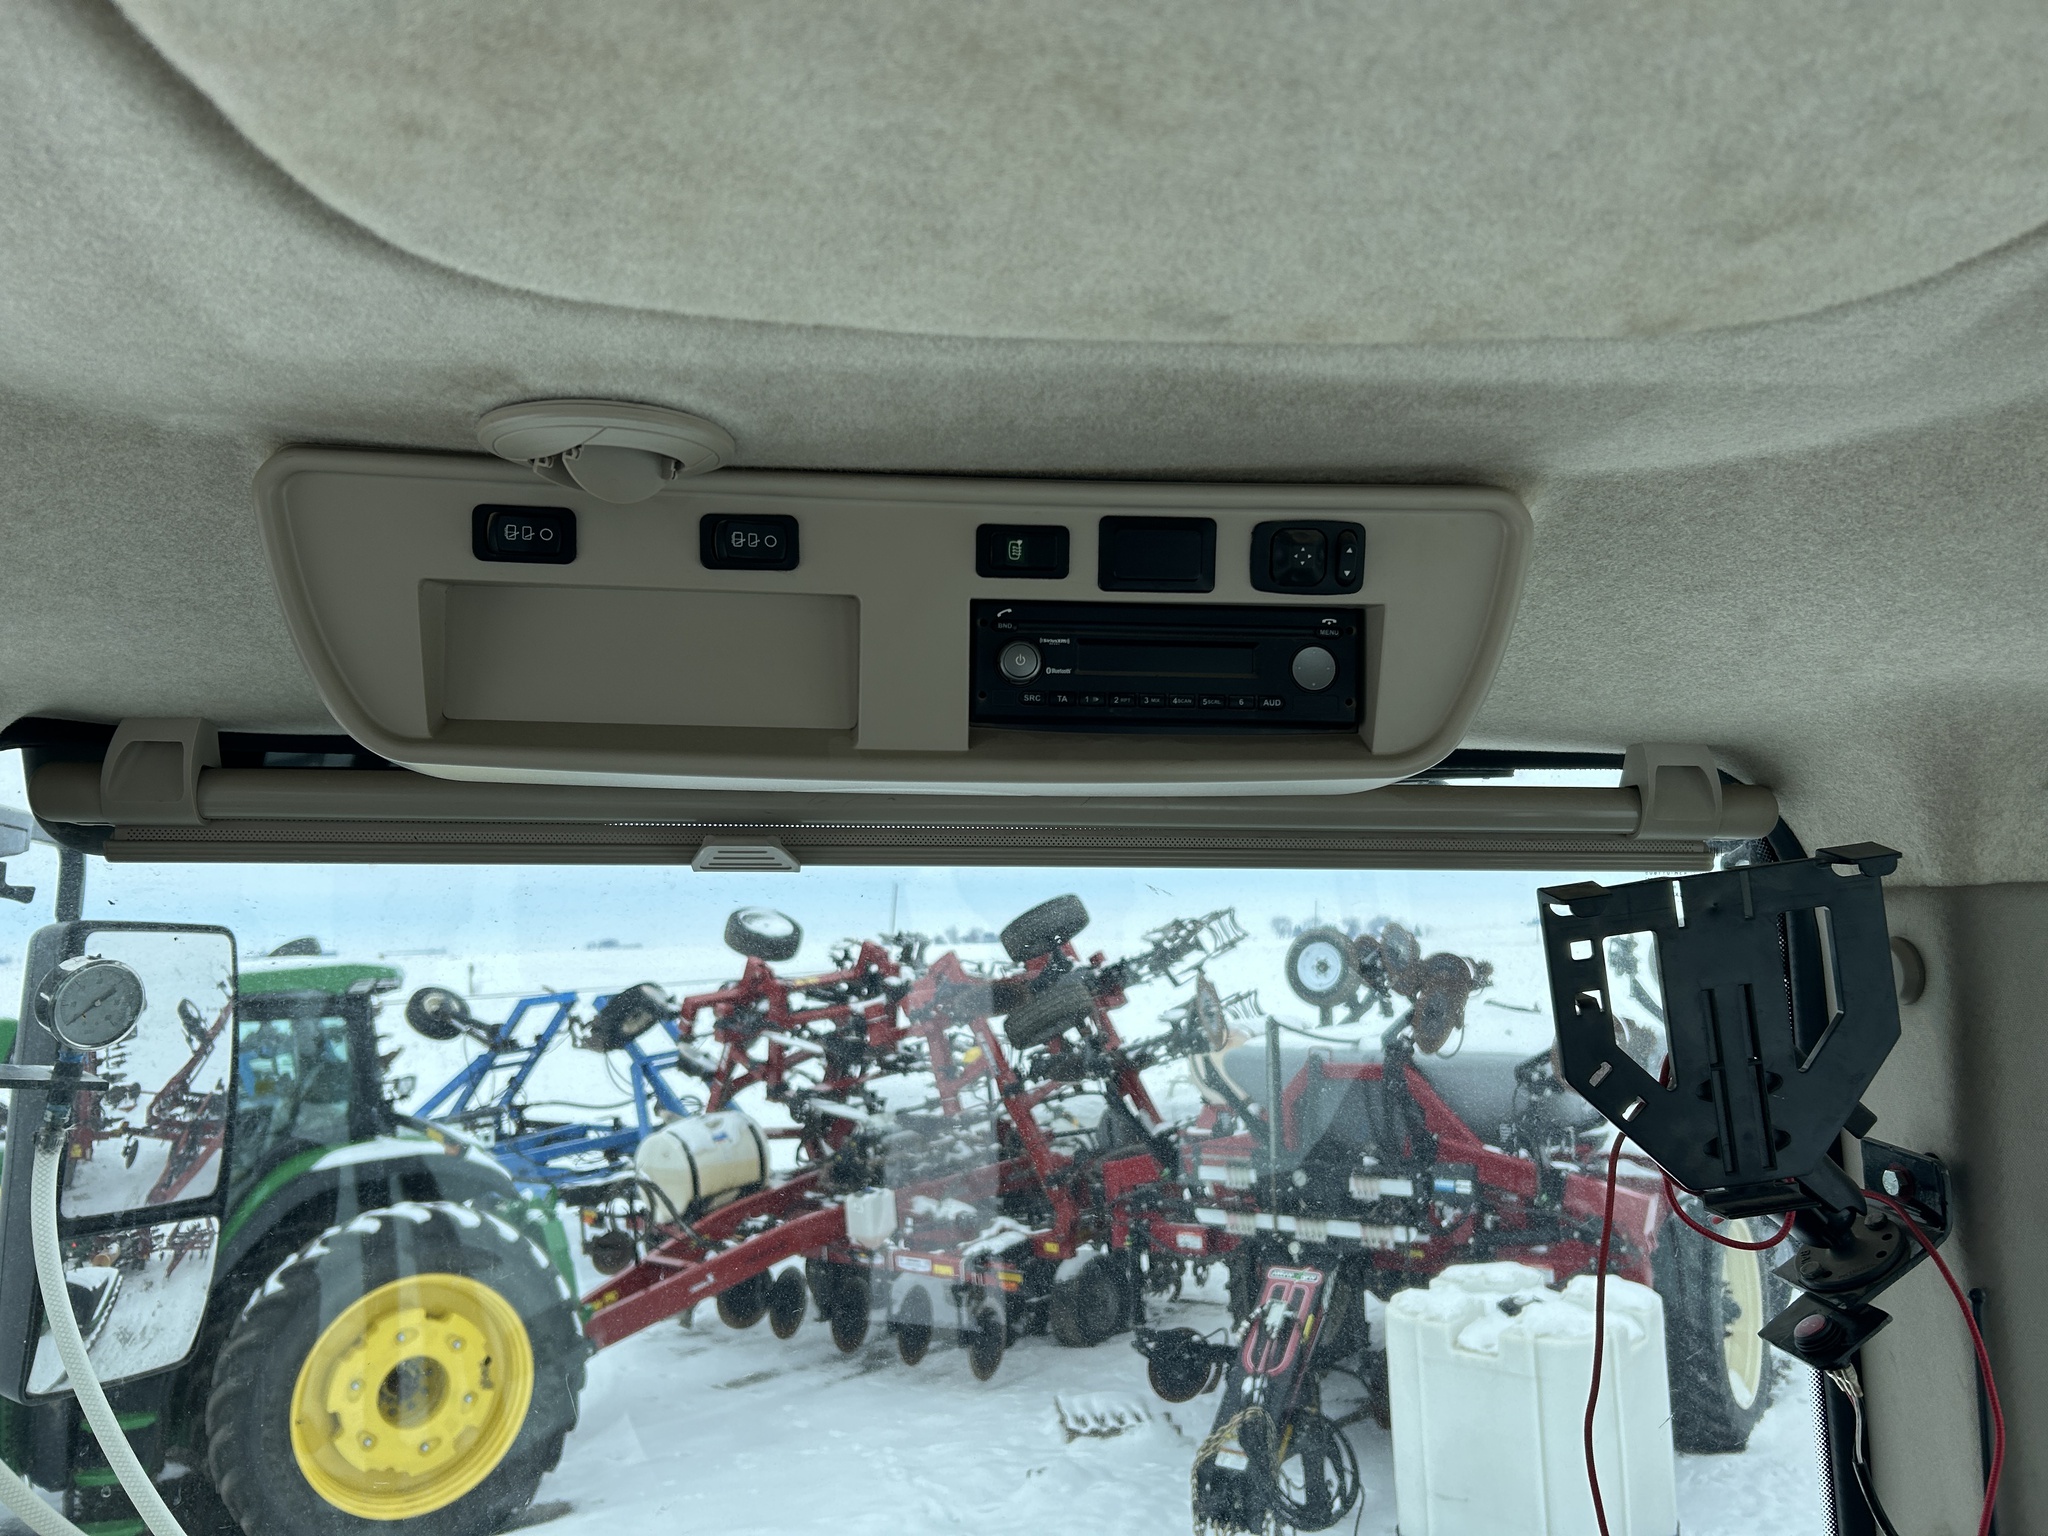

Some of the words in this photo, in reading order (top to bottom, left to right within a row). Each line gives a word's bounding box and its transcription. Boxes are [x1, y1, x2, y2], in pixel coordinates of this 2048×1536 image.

[1023, 694, 1041, 702] SRC
[1057, 695, 1068, 703] TA
[1238, 698, 1245, 706] 6
[1262, 699, 1282, 707] AUD
